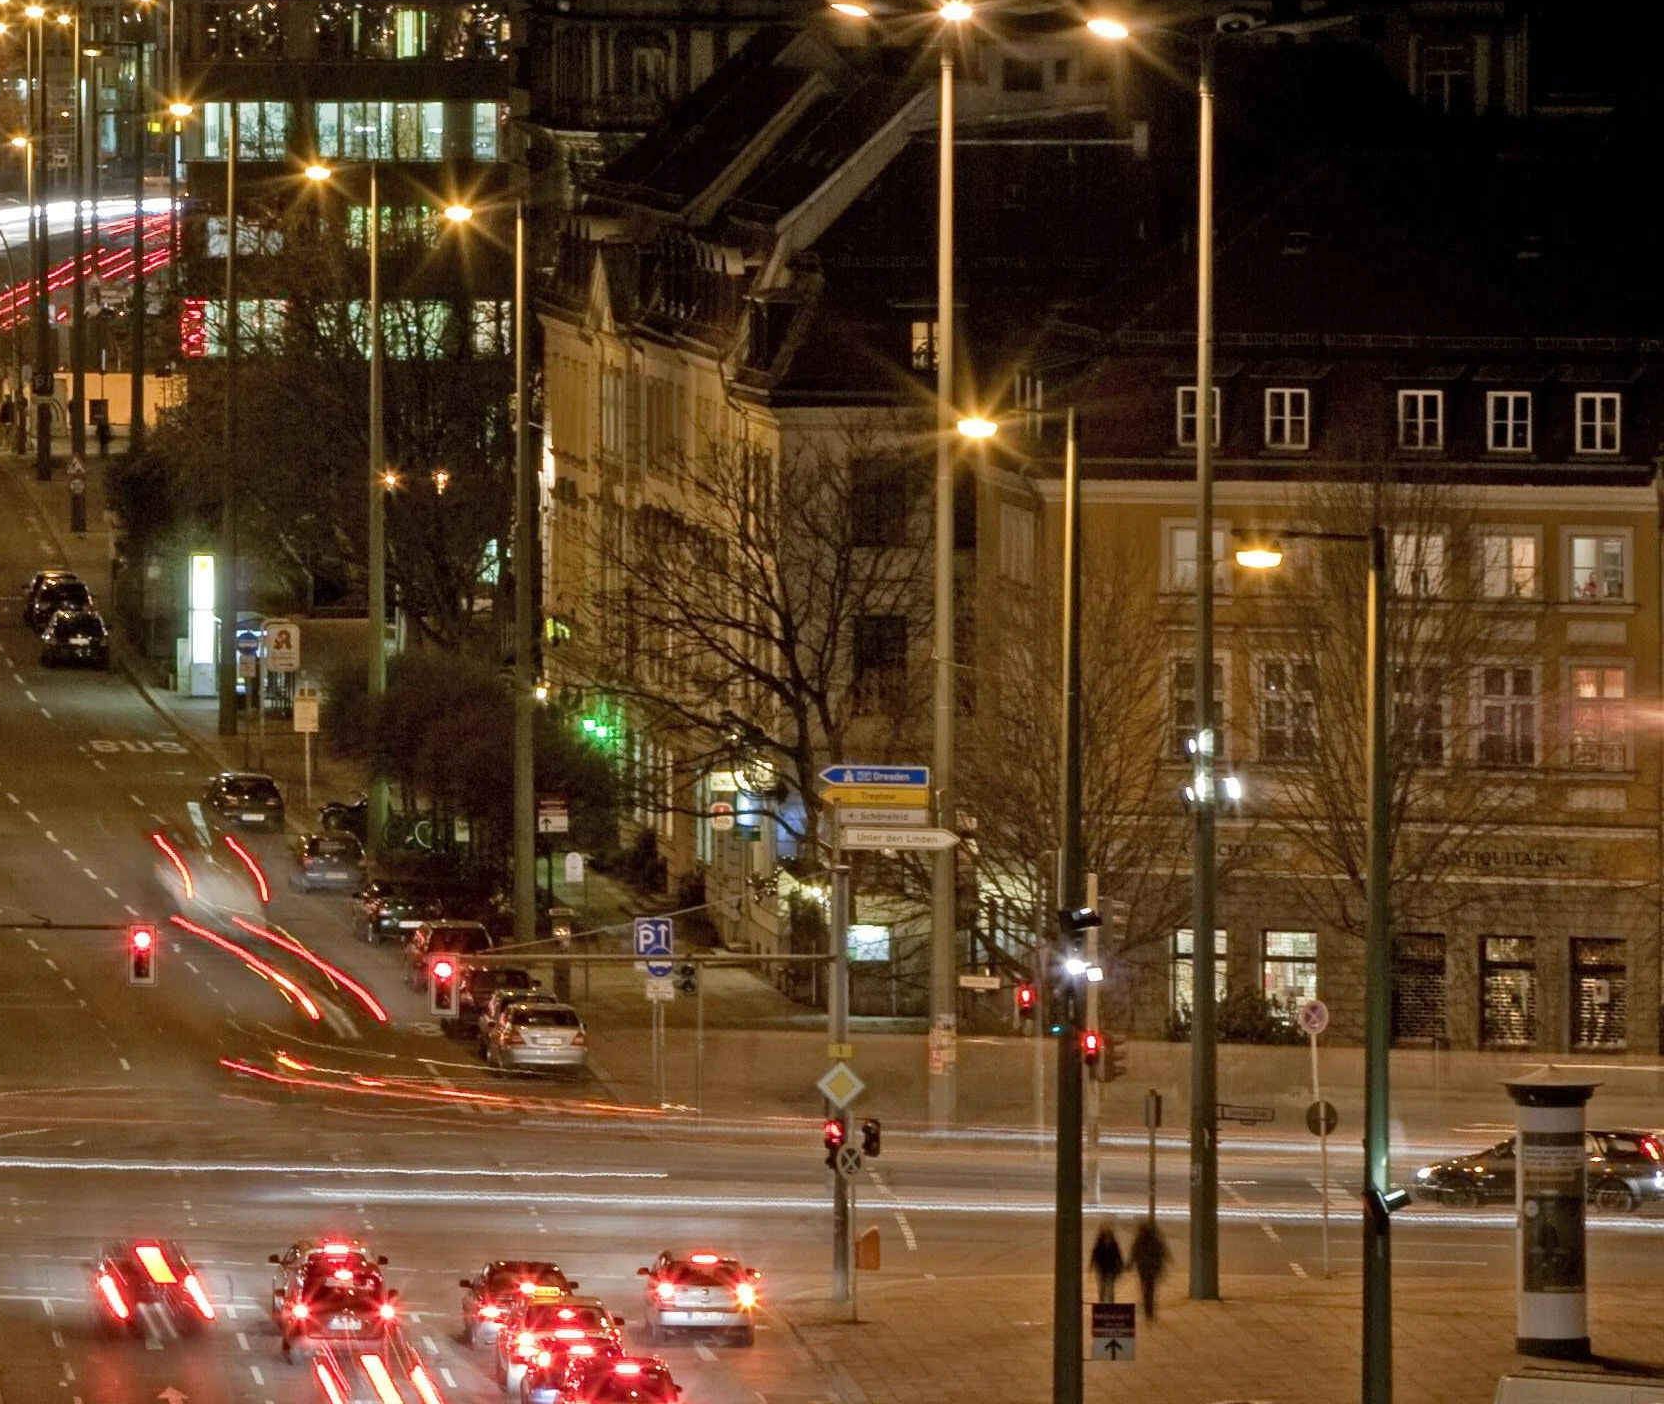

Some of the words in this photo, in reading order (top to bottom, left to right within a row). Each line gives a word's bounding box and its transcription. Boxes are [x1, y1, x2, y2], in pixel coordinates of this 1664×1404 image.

[89, 740, 190, 754] BUS
[873, 772, 911, 782] Dresden
[861, 791, 896, 801] Treptow
[860, 810, 910, 821] Schönefeld
[856, 831, 882, 842] Unter
[886, 833, 903, 842] den
[906, 834, 938, 844] Linden
[638, 929, 655, 953] P
